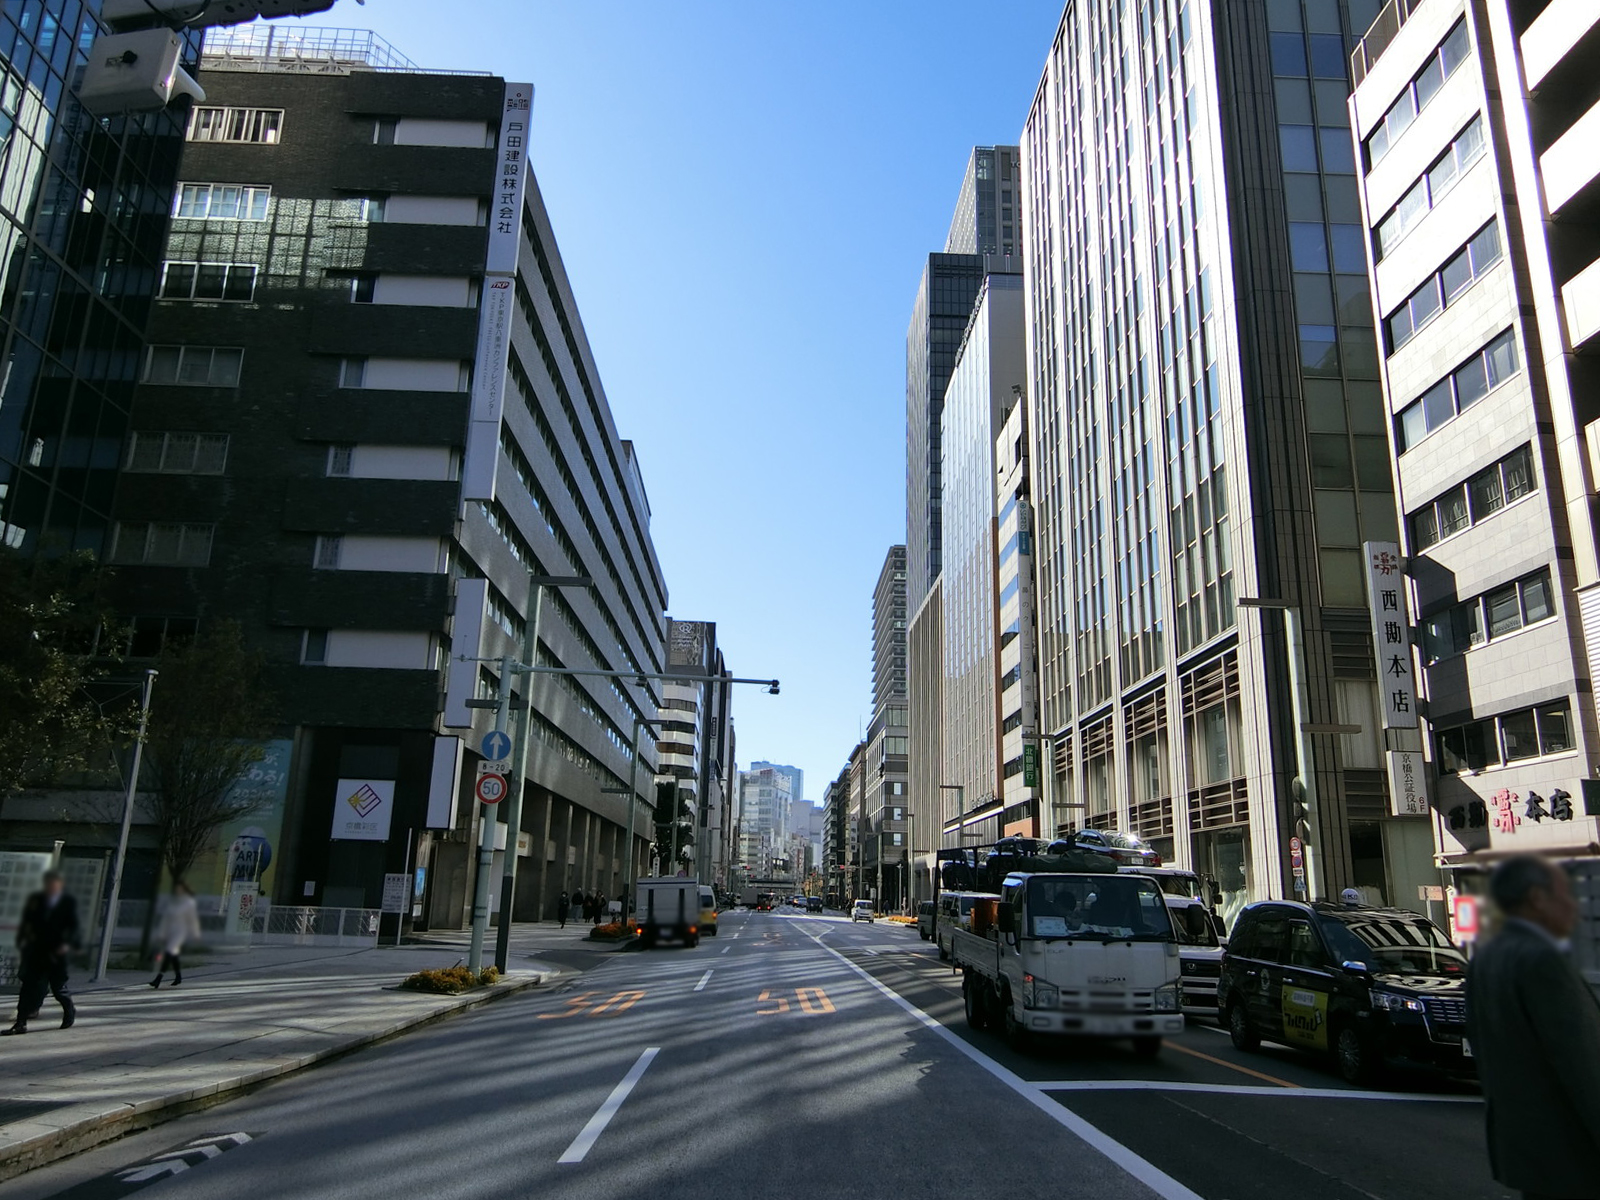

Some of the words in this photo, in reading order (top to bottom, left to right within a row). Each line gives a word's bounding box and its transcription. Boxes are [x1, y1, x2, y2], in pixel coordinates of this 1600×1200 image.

[497, 122, 523, 234] 戸田建設株式会社
[491, 281, 510, 289] TKP
[1380, 589, 1409, 713] 西勘本店
[482, 781, 501, 796] 50
[1525, 788, 1574, 823] 本店
[538, 990, 647, 1019] 50
[756, 987, 837, 1015] 50
